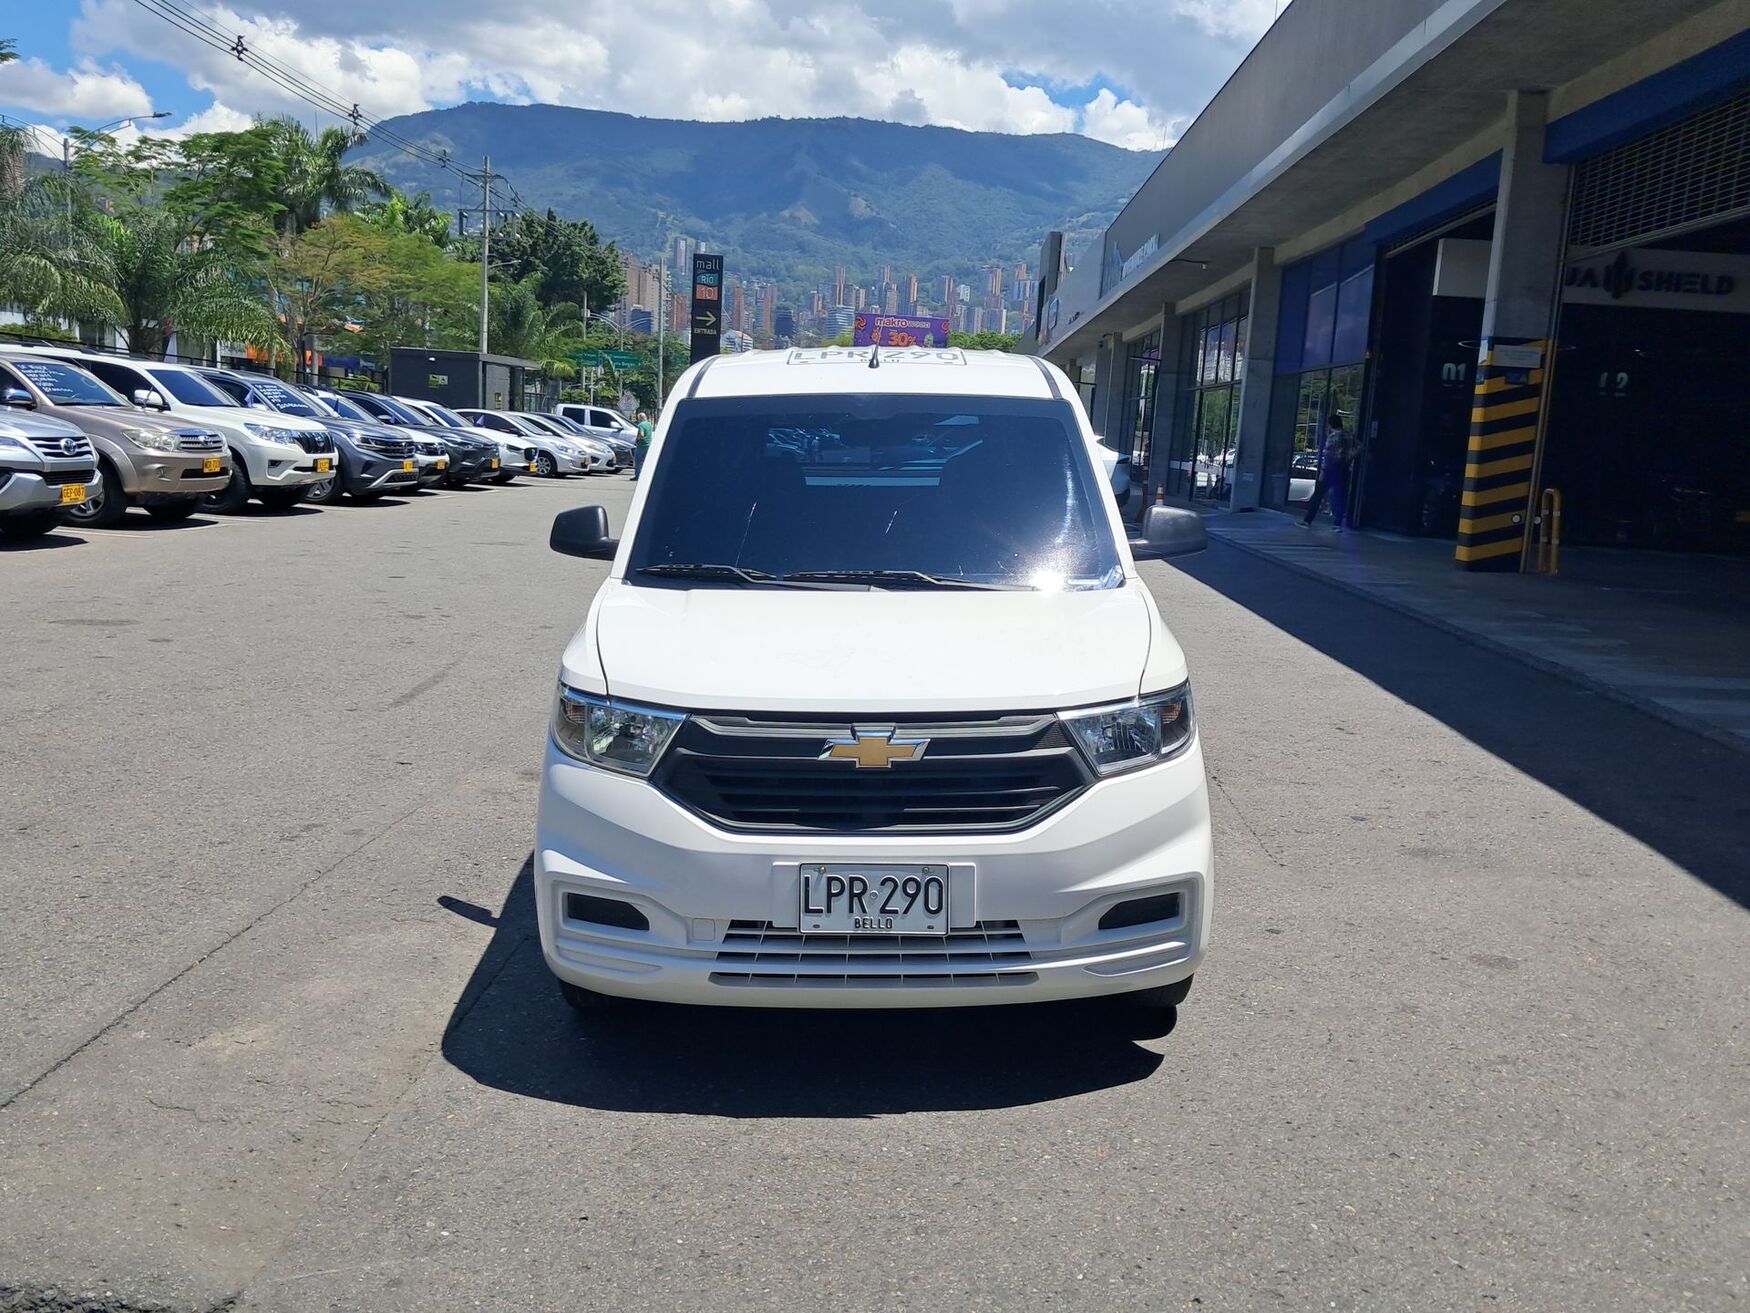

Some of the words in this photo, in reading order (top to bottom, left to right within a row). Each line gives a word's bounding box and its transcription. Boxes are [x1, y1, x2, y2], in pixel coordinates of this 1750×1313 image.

[696, 258, 720, 270] mall
[1637, 269, 1736, 295] SHIELD
[701, 287, 714, 299] 10
[694, 327, 717, 335] ENTRADA
[853, 917, 894, 930] BELLO
